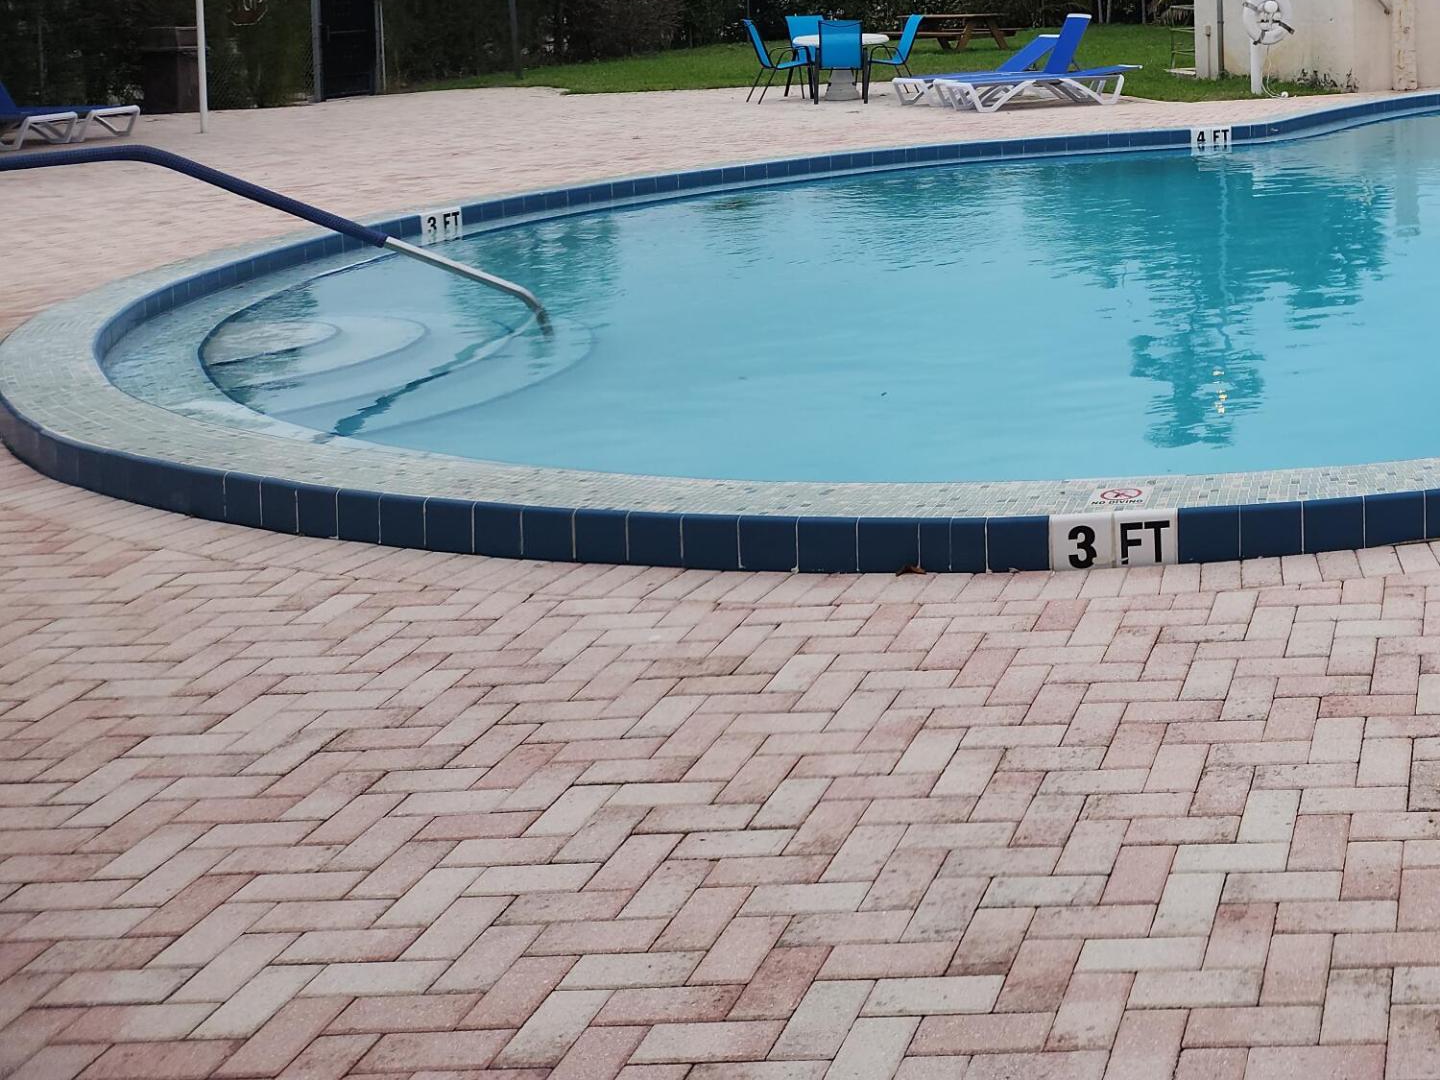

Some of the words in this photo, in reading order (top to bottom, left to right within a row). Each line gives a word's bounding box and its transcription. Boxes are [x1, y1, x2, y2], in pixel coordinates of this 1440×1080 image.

[1197, 131, 1206, 144] 4
[1213, 129, 1229, 143] FT
[427, 216, 437, 232] 3
[443, 211, 459, 229] FT
[1068, 525, 1097, 569] 3
[1120, 520, 1170, 565] FT
